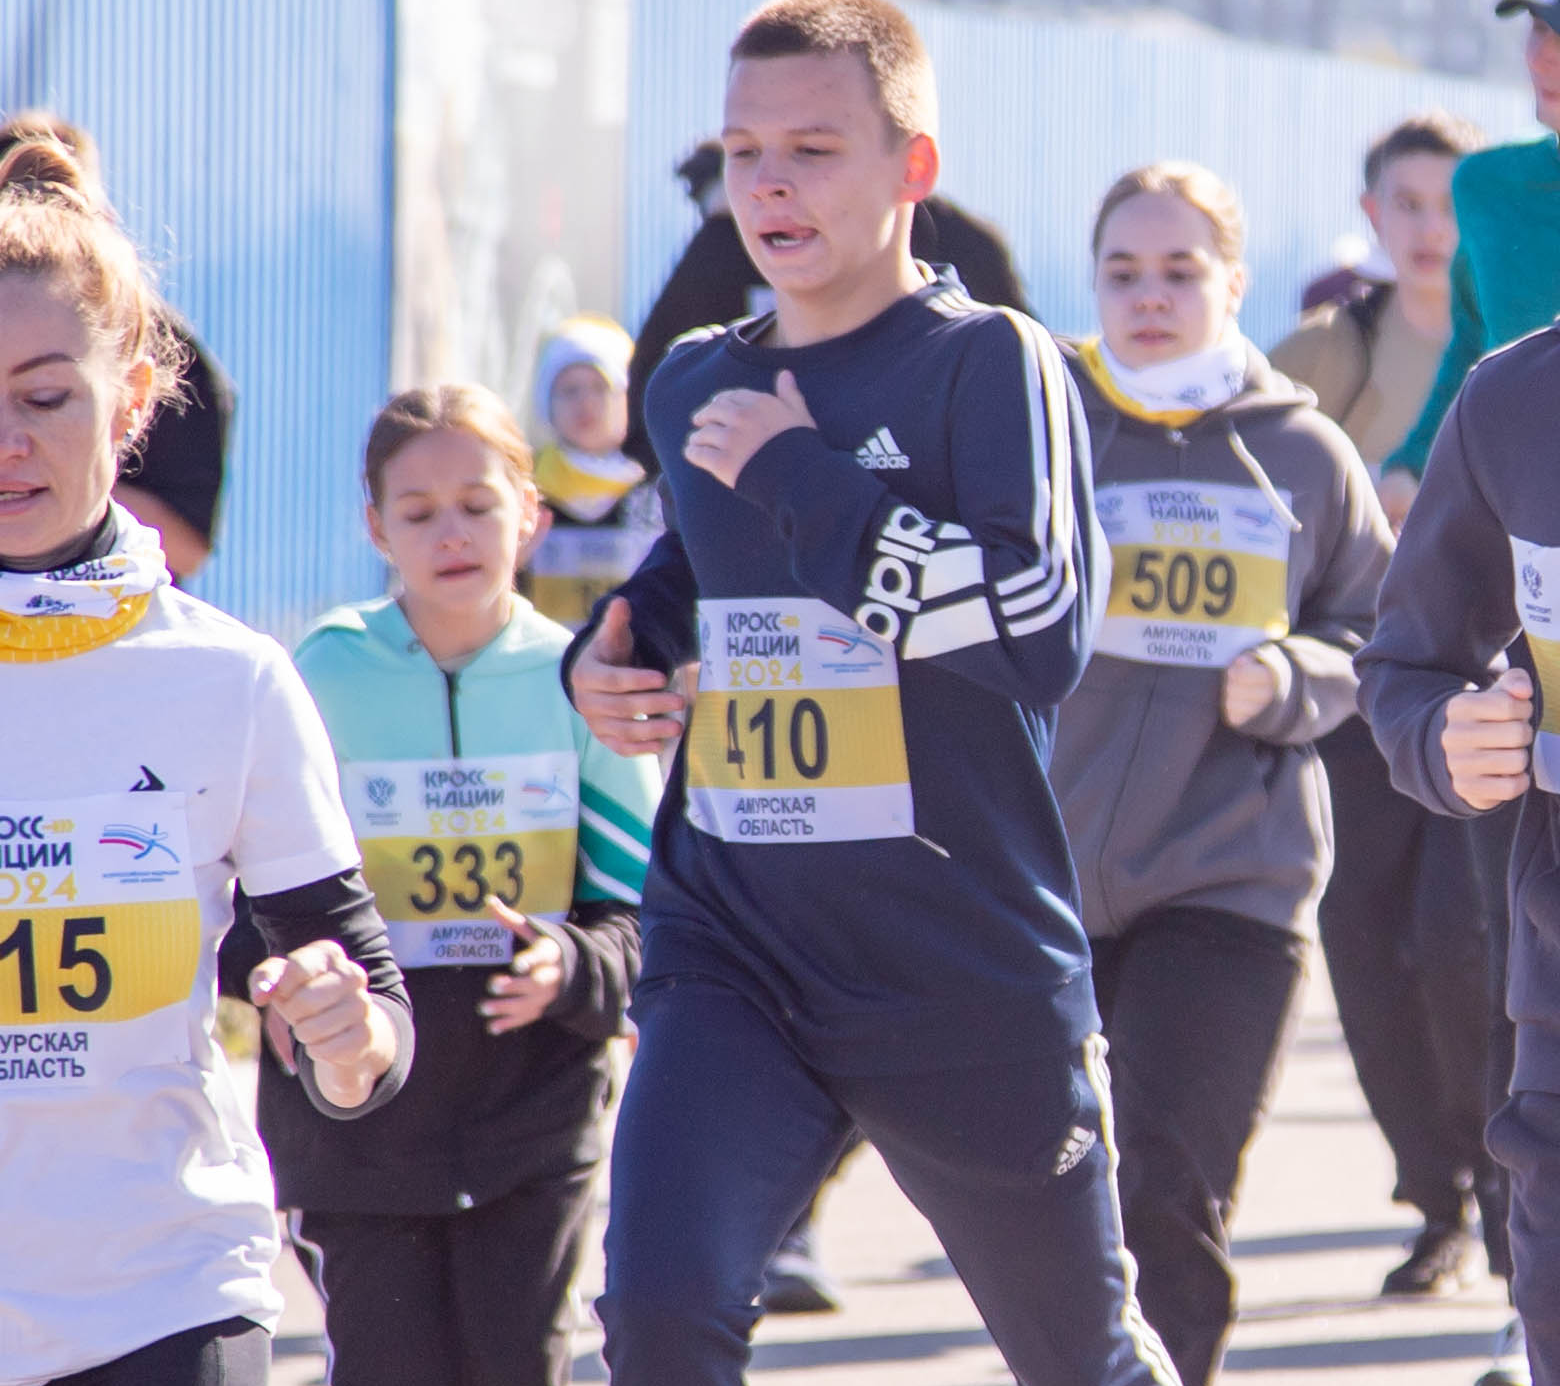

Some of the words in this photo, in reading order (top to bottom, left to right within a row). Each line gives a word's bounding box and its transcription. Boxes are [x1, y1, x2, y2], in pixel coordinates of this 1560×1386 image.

[1149, 505, 1219, 522] НАЦИИ
[1131, 550, 1237, 617] 509
[726, 612, 781, 632] КРОСС
[1143, 626, 1217, 645] АМУРСКАЯ
[727, 635, 800, 658] НАЦИИ
[1147, 643, 1213, 661] ОБЛАСТЬ
[729, 659, 803, 686] 2024
[727, 698, 828, 780] 410
[424, 769, 486, 788] КРОСС
[425, 788, 504, 810] НАЦИИ
[736, 796, 817, 814] АМУРСКАЯ
[429, 809, 507, 835] 2024
[738, 818, 814, 836] ОБЛАСТЬ
[410, 841, 524, 913] 333
[435, 943, 505, 959] ОБЛАСТЬ
